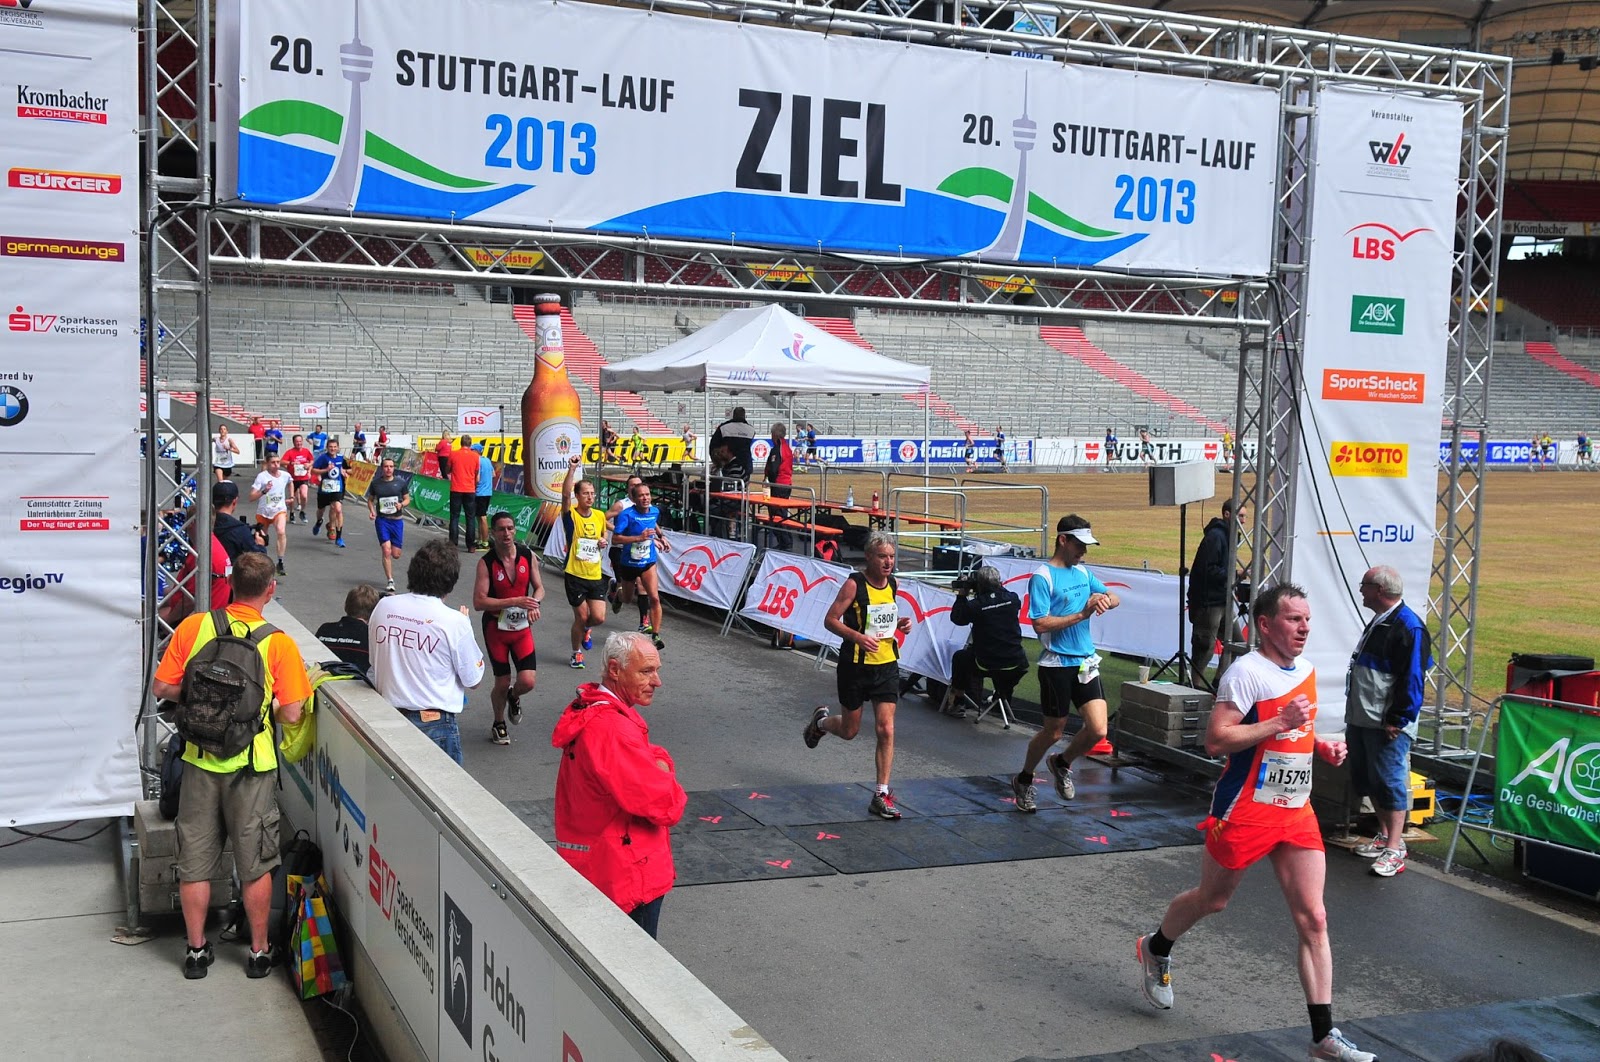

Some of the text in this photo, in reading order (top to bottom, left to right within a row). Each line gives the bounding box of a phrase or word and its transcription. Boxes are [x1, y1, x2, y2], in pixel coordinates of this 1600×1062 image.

[269, 35, 675, 113] 20. STUTTGART-LAUF
[17, 85, 108, 111] Krombacher
[24, 108, 101, 121] ALKOHOLFREI
[1371, 109, 1414, 123] Veranstalter
[485, 113, 597, 175] 2013
[736, 88, 902, 202] ZIEL
[963, 113, 1256, 171] 20. STUTTGART-LAUF
[19, 172, 111, 192] BÜRGER
[1114, 174, 1196, 225] 2013
[1513, 223, 1568, 235] Krombacher
[7, 242, 118, 259] germanwings
[1352, 236, 1396, 261] LBS
[59, 315, 118, 326] Sparkassen
[1360, 303, 1397, 322] AOK
[54, 325, 118, 337] Versicherung
[22, 372, 34, 382] by
[1329, 373, 1418, 392] SportScheck
[464, 416, 484, 425] LBS
[1356, 447, 1403, 464] LOTTO
[1358, 524, 1414, 543] EnBW
[673, 561, 708, 591] LBS
[758, 583, 798, 618] LBS
[386, 613, 424, 626] germanwings
[874, 614, 894, 624] H5808
[375, 625, 440, 654] CREW
[1269, 769, 1311, 785] H15793
[1272, 798, 1288, 806] LBS
[1500, 788, 1523, 805] Die
[397, 880, 435, 954] Sparkassen
[393, 910, 434, 995] Versicherung
[483, 941, 526, 1044] Hahn
